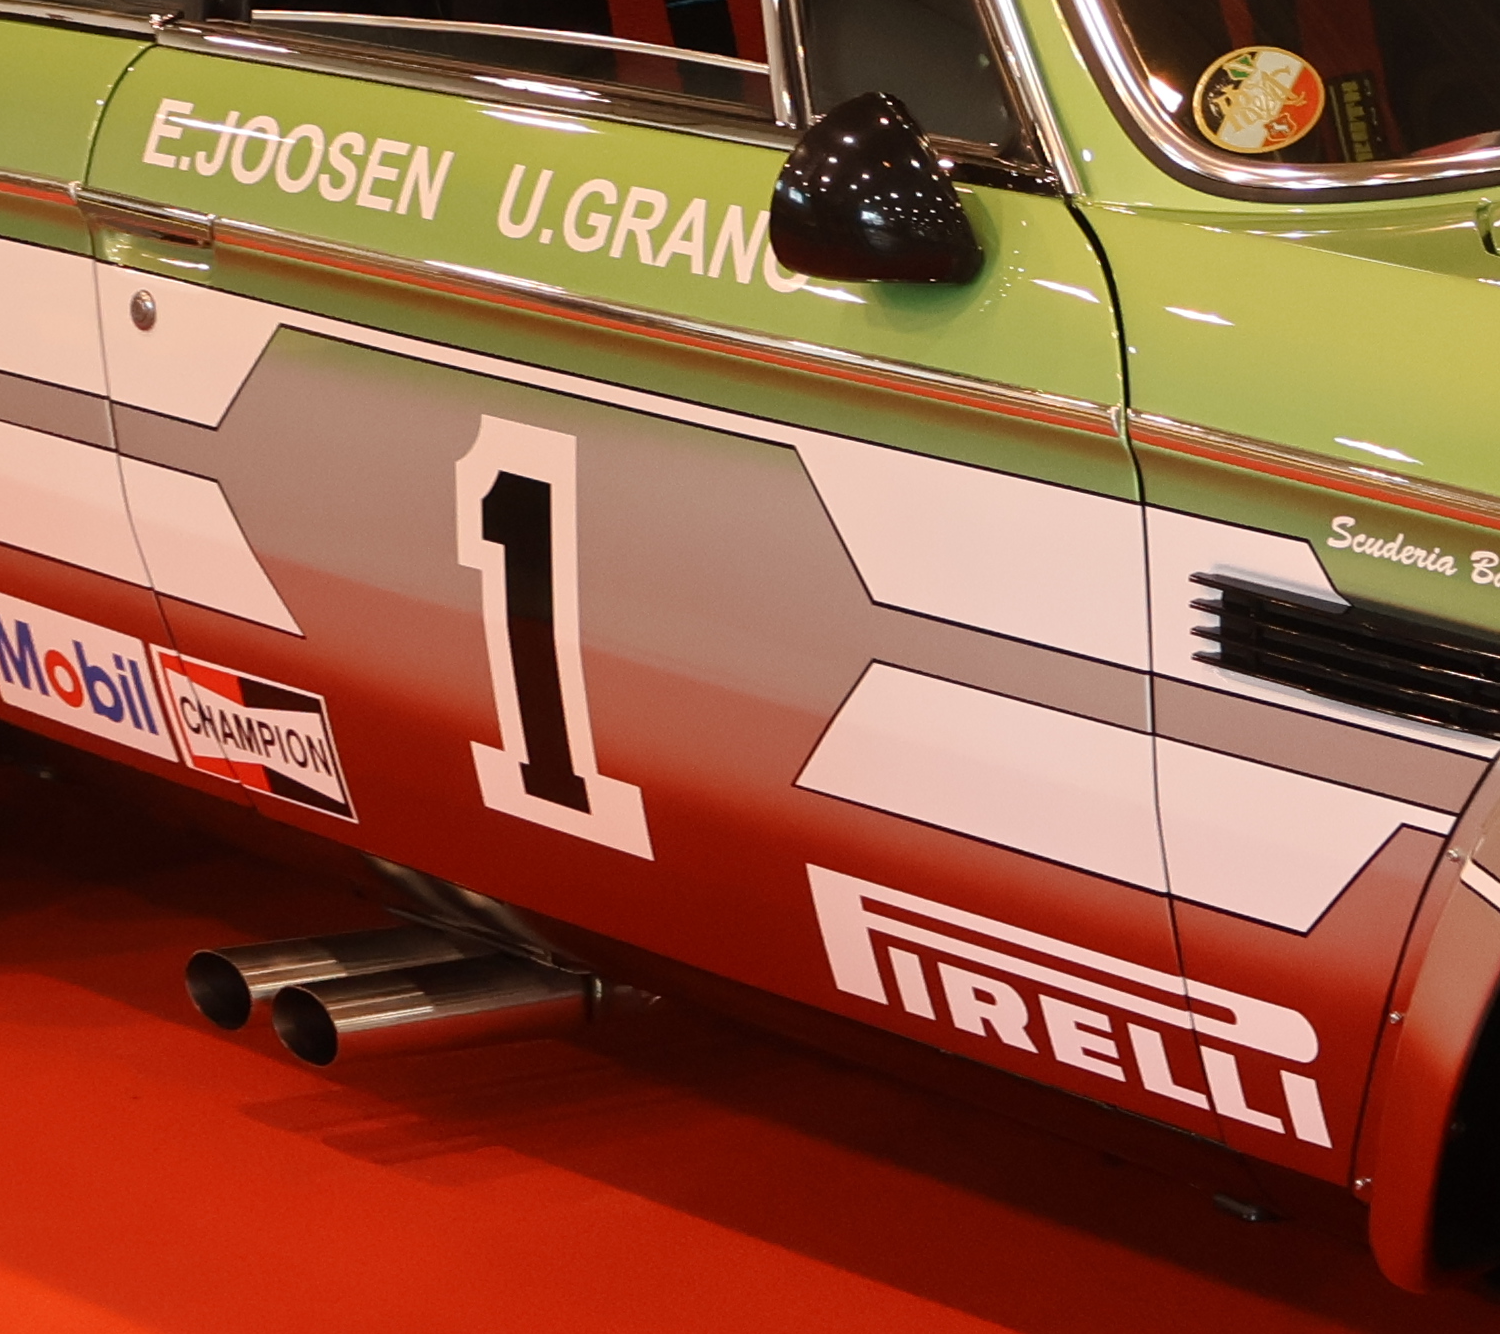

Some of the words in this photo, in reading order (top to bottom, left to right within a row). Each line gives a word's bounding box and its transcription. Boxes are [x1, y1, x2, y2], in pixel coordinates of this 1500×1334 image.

[142, 98, 455, 220] E.JOOSEN
[1327, 515, 1459, 577] Scuderia
[455, 413, 655, 861] 1
[180, 695, 333, 778] CHAMPION
[806, 862, 1333, 1150] PIRELLI
